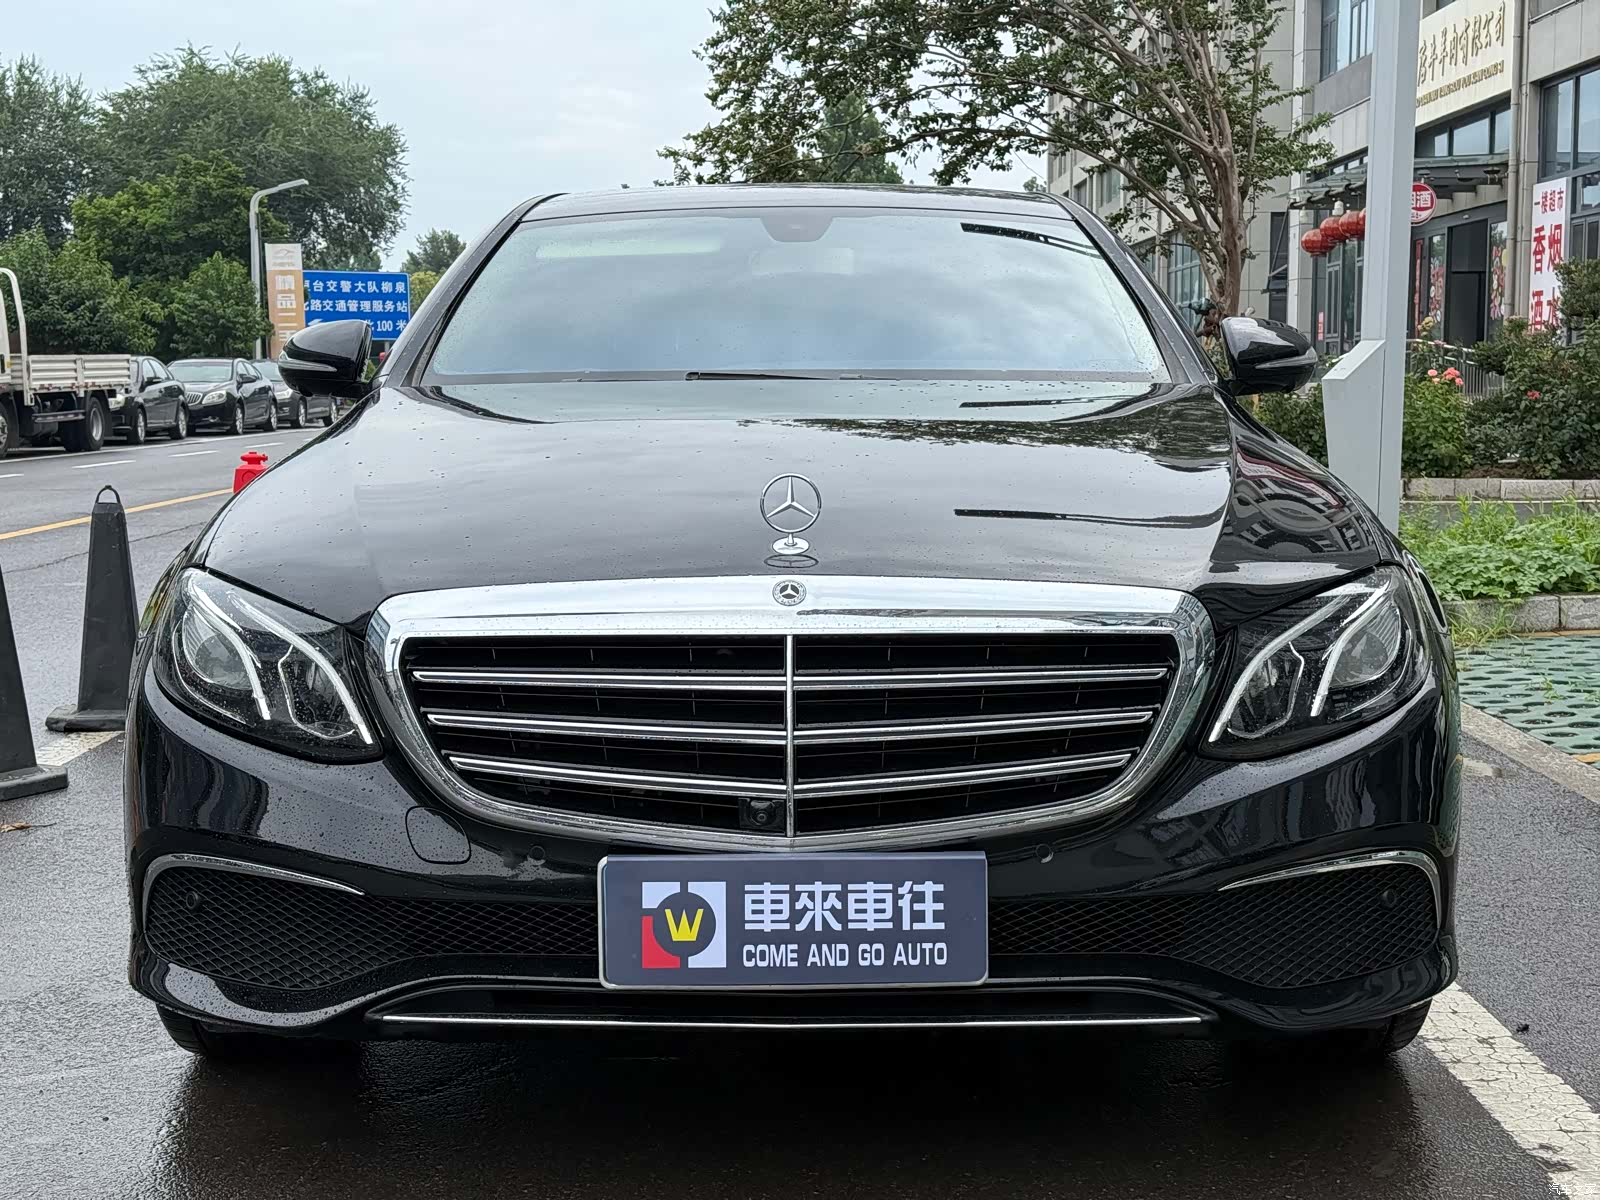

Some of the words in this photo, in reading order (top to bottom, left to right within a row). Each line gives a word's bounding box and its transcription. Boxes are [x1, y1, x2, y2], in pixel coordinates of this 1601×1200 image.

[1534, 187, 1564, 214] 一楼超市
[1533, 224, 1563, 275] 香烟
[744, 881, 946, 932] 車來車往
[743, 943, 798, 968] COME
[807, 943, 849, 967] AND
[858, 943, 885, 967] GO
[893, 942, 948, 966] AUTO
